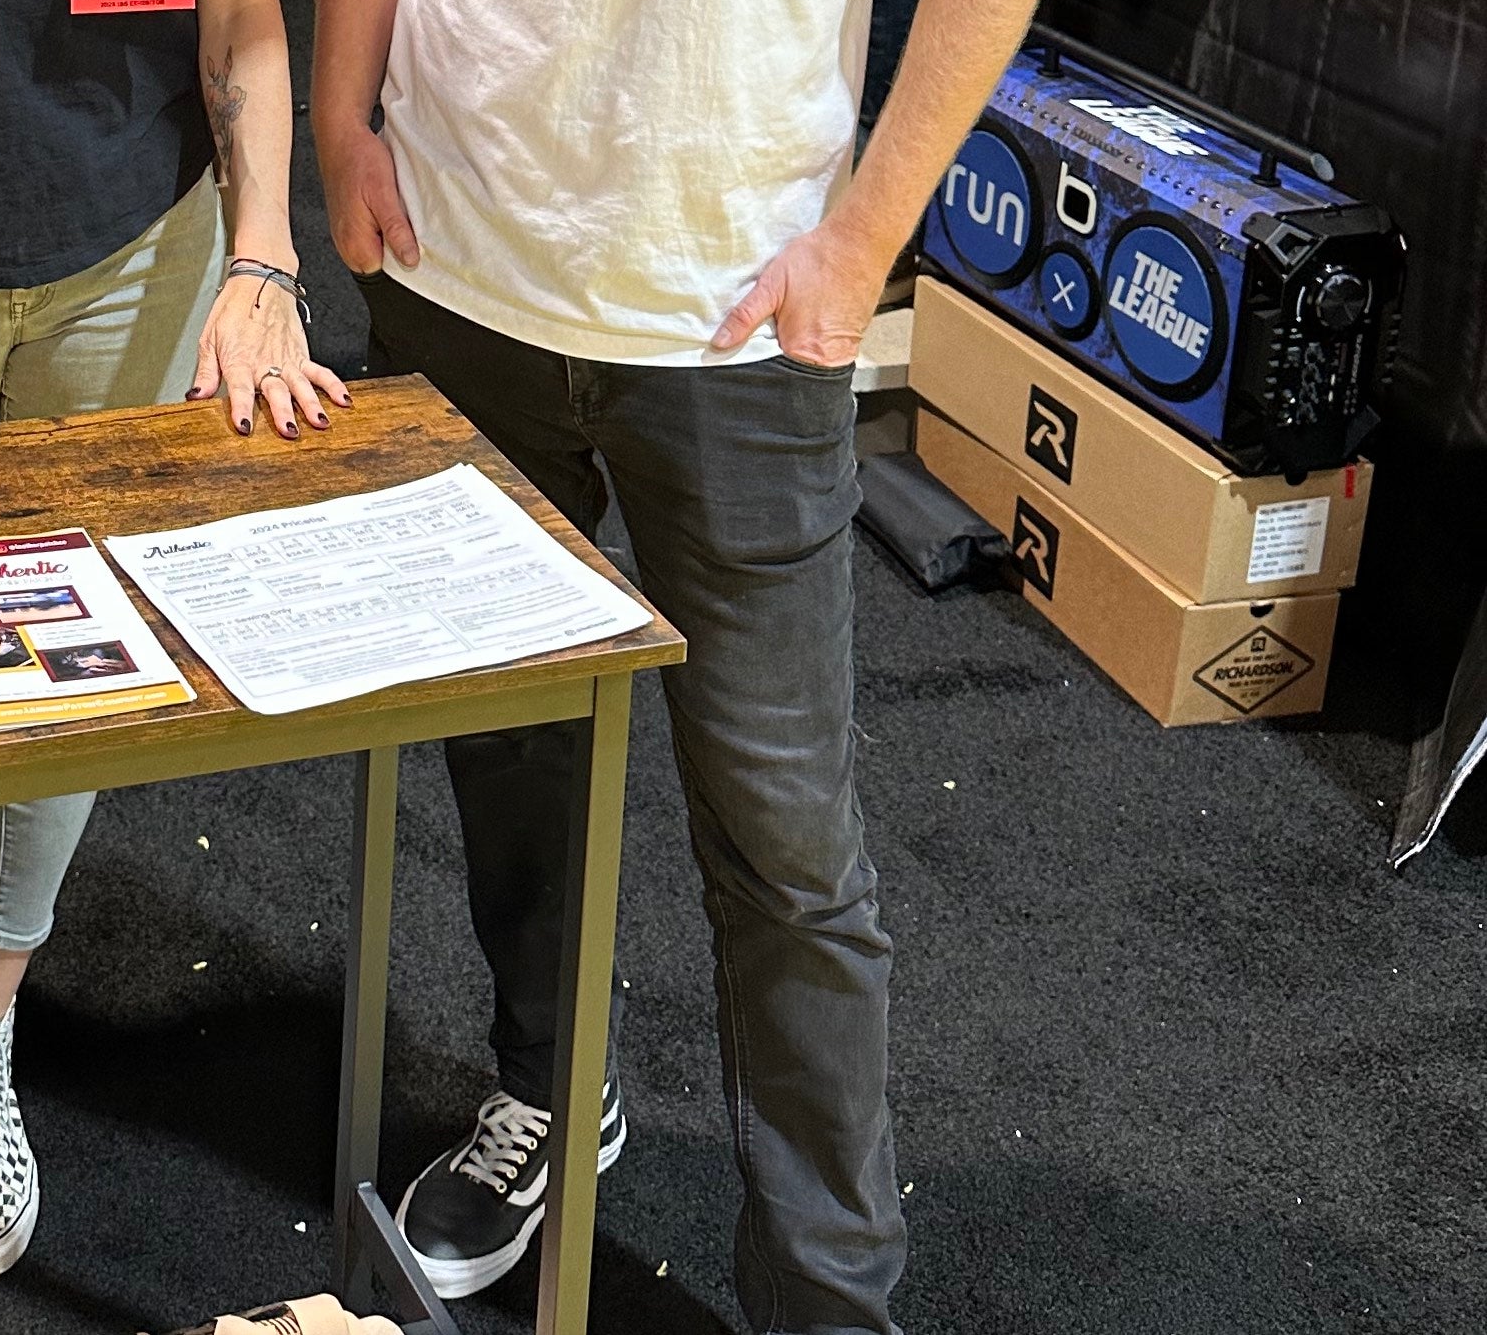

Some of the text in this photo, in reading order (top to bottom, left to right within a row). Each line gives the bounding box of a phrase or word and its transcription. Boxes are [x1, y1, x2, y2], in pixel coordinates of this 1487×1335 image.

[942, 164, 1026, 246] run
[1133, 250, 1183, 305] THE
[1108, 274, 1211, 360] LEAGUE
[1213, 660, 1294, 682] RICHARDSON
